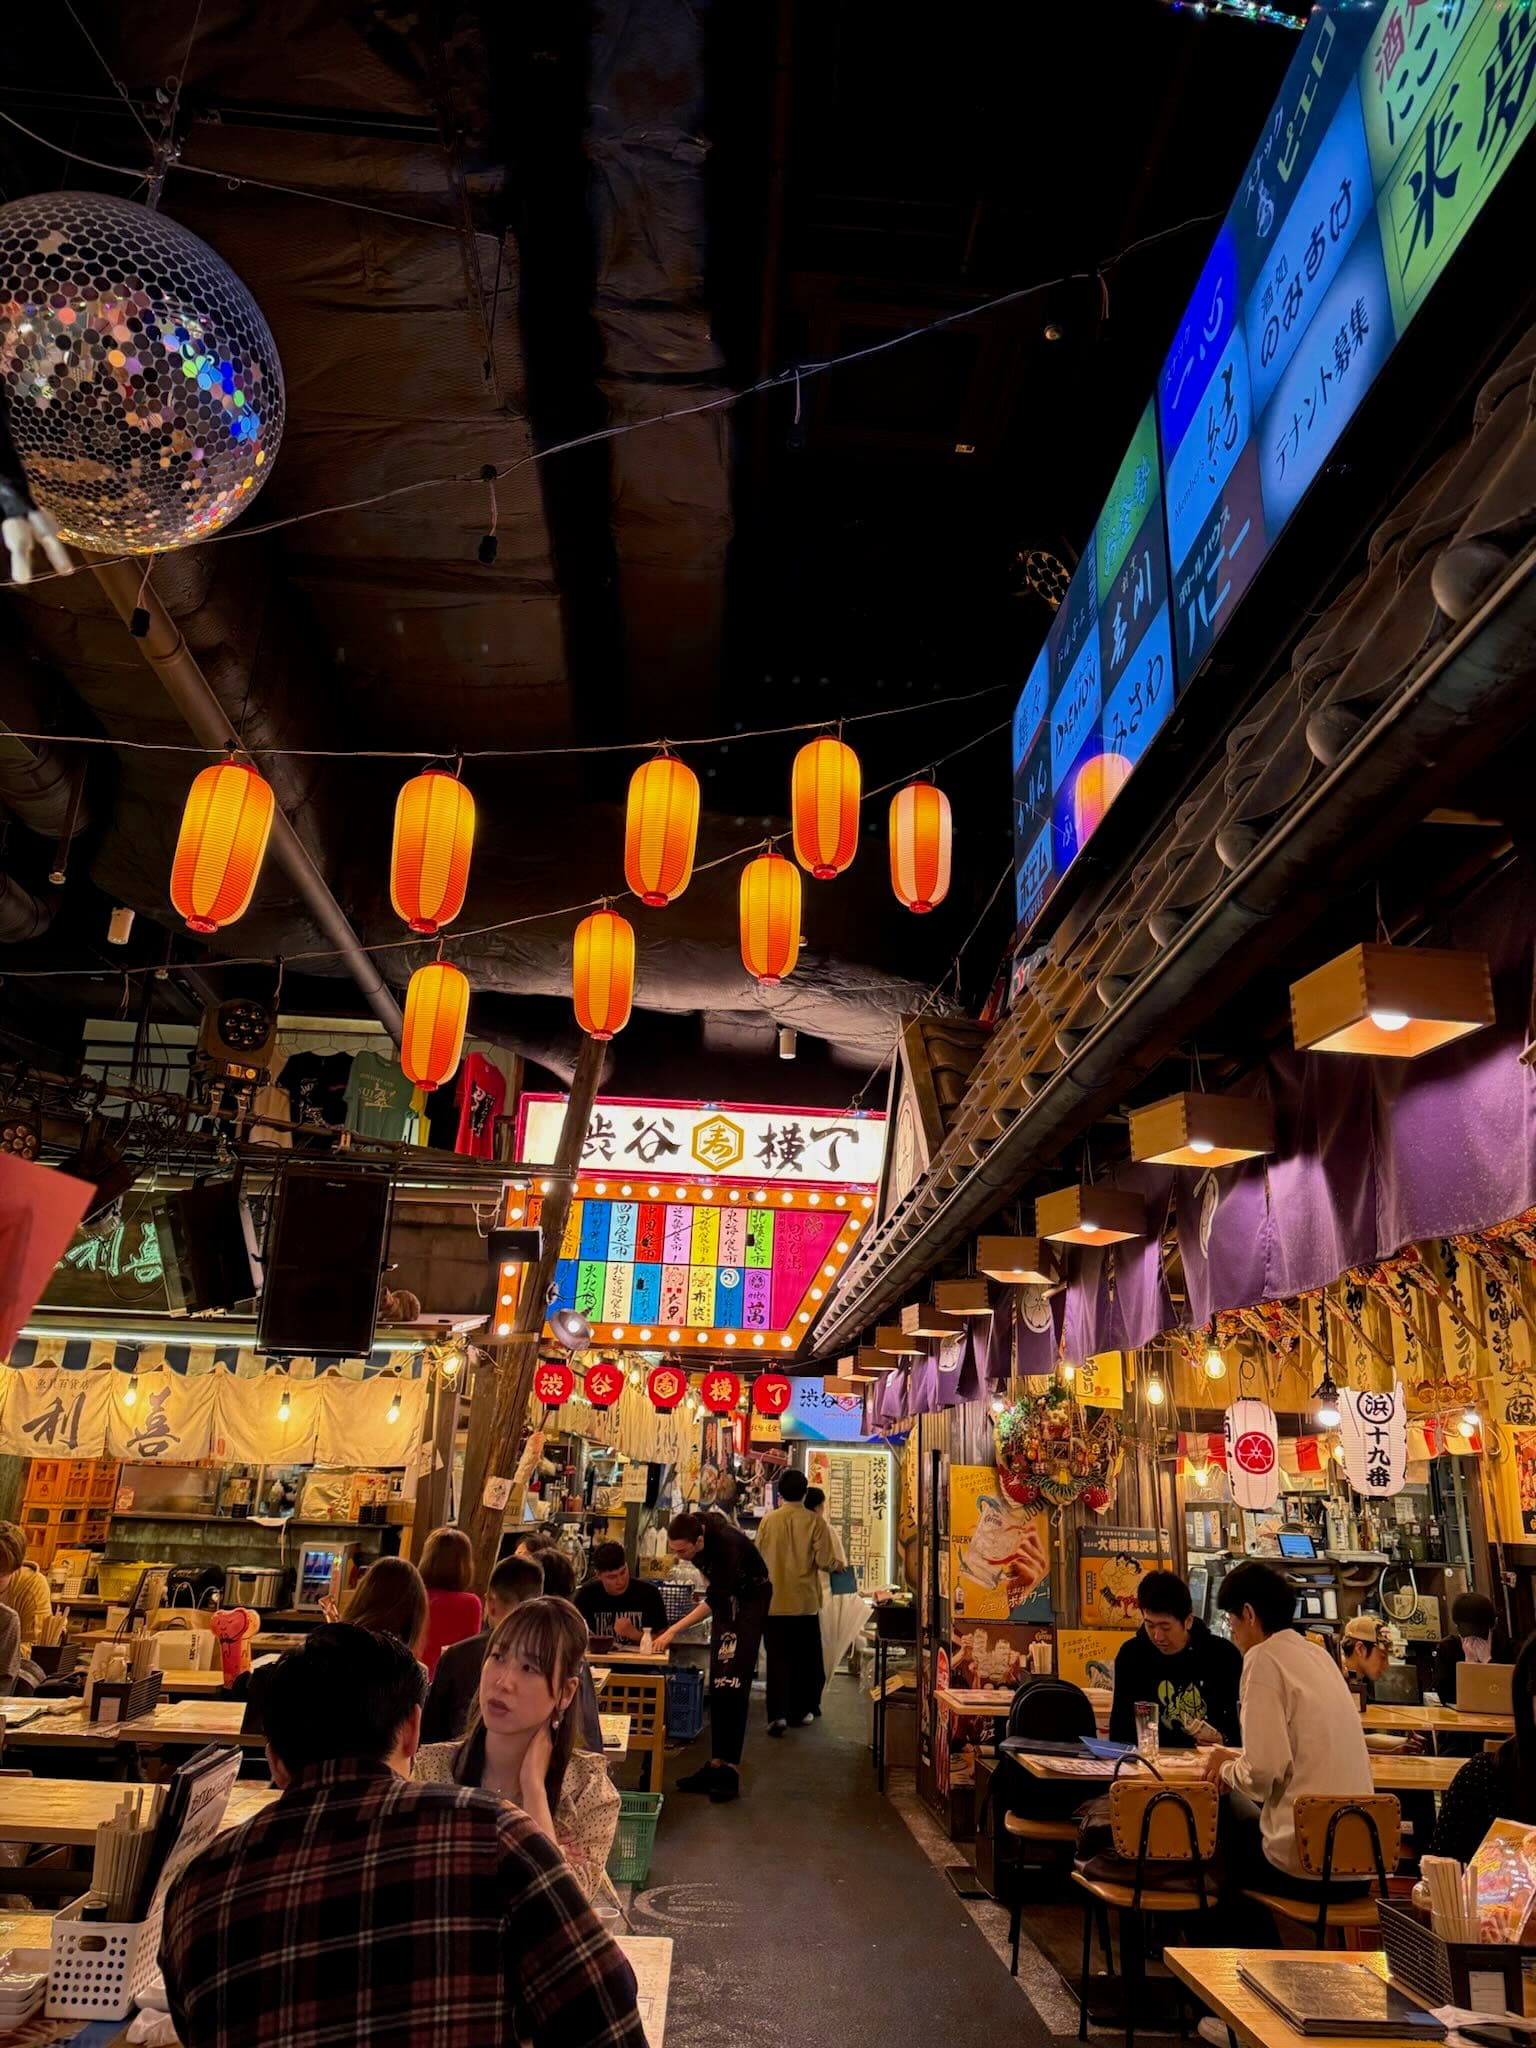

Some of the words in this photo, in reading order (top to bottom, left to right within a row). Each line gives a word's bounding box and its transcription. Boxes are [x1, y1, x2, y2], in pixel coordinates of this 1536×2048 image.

[1244, 108, 1284, 207] スナック
[1277, 15, 1337, 183] ピエロ
[1260, 177, 1353, 369] のみすけ
[1171, 276, 1224, 410] 一心
[1276, 295, 1370, 481] テナント募集
[1179, 504, 1232, 609] ボトルハウス
[1188, 517, 1250, 659] ハニー
[1110, 654, 1164, 756] みさわ
[753, 1122, 860, 1172] 横丁
[872, 1456, 888, 1521] 渋谷横丁
